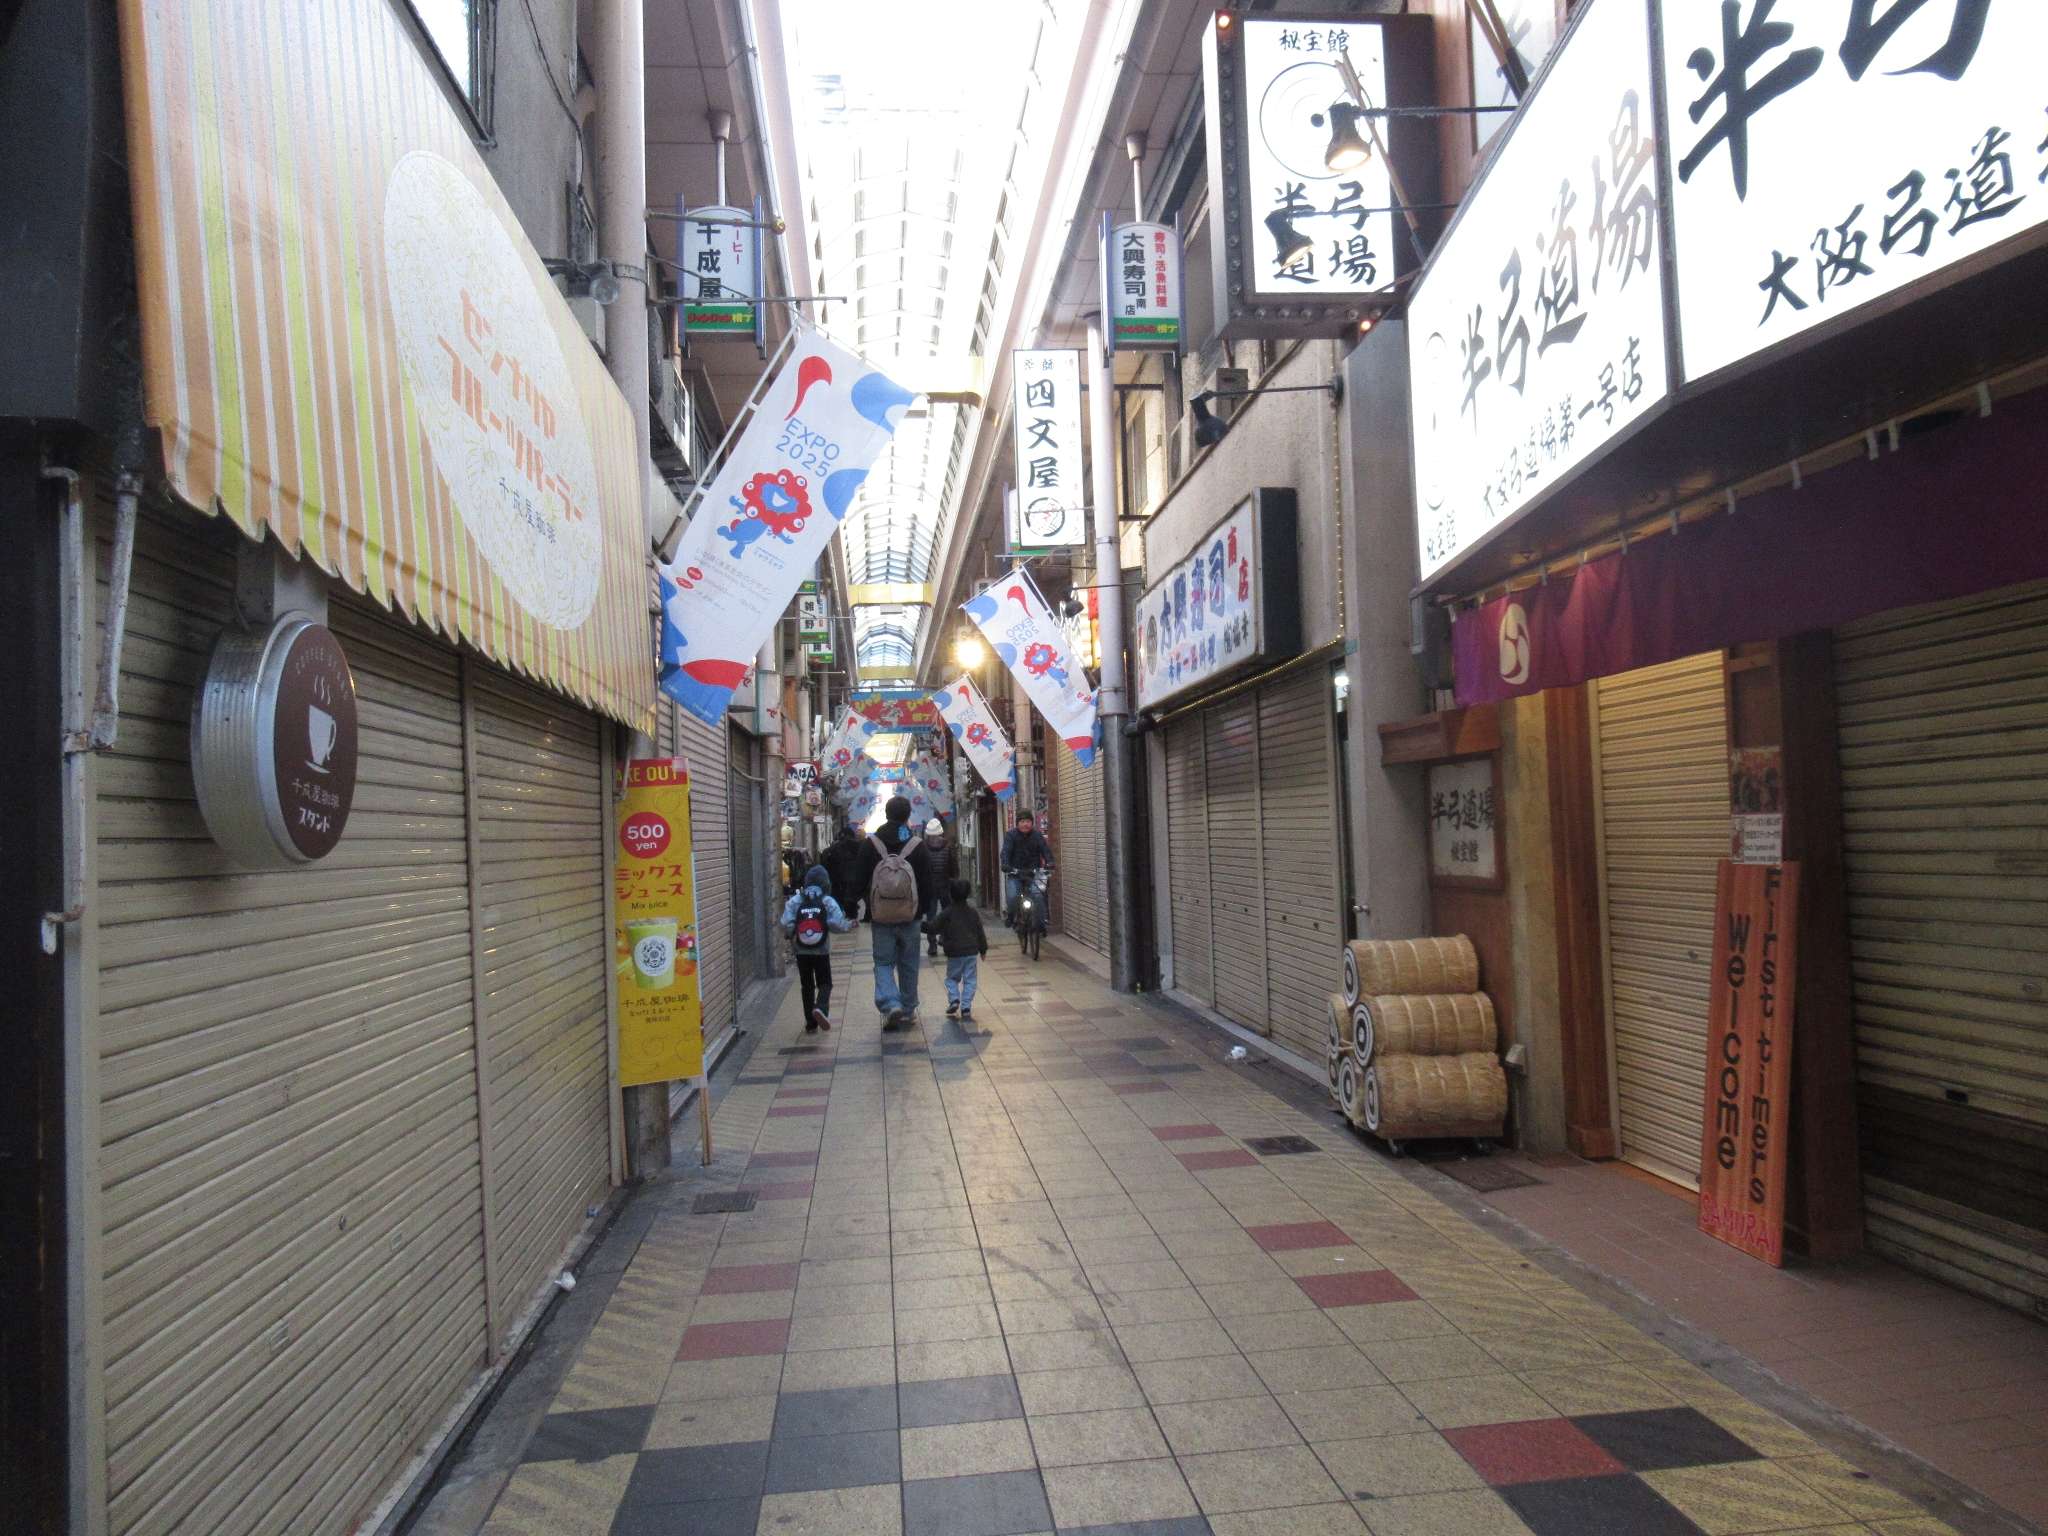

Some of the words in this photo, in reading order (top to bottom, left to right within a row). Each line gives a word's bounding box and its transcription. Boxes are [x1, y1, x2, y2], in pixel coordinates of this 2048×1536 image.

[1279, 28, 1350, 52] 秘宝館
[1757, 104, 2048, 328] 大阪弓道
[732, 218, 743, 264] ーヒー
[1460, 88, 1656, 436] 半弓道場
[775, 434, 830, 478] 2025
[785, 416, 840, 461] EXPO
[1026, 378, 1061, 489] 四文屋
[299, 806, 331, 832] スタンド
[1431, 785, 1497, 832] 半弓道場
[627, 824, 665, 840] 500
[635, 841, 657, 851] yen
[616, 864, 683, 881] ミックス
[616, 882, 685, 900] ジュース
[631, 901, 646, 911] Mix
[1759, 868, 1783, 1018] First
[1716, 912, 1750, 1170] Welcome
[1750, 1032, 1772, 1205] timers
[1702, 1194, 1777, 1254] SAMURAI
